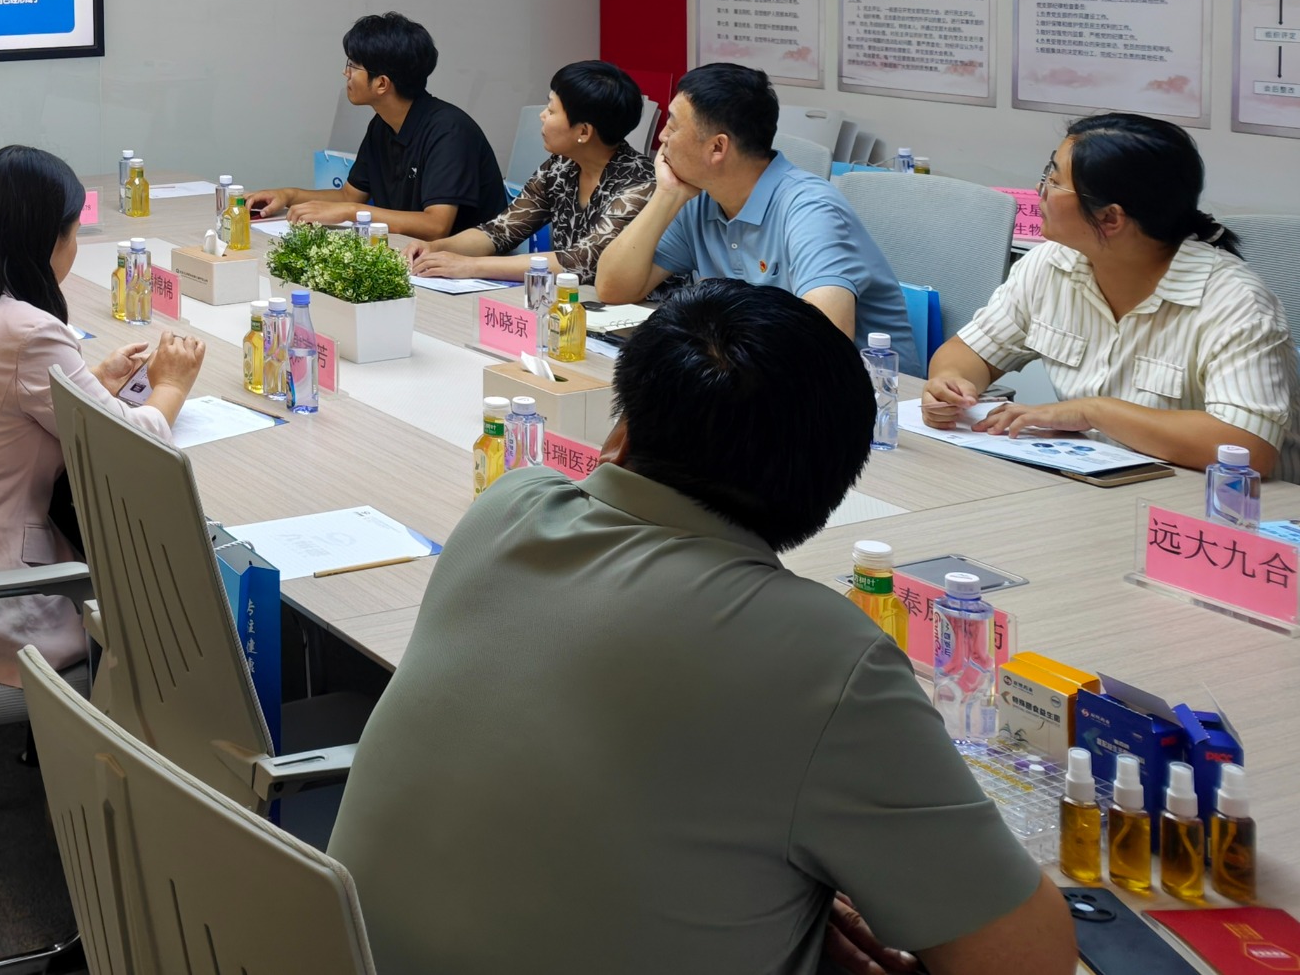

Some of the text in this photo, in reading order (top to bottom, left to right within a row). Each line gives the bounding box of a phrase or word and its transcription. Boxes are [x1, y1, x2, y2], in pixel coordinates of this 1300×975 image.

[484, 306, 529, 339] 孙晓京
[1149, 518, 1297, 589] 远大九合
